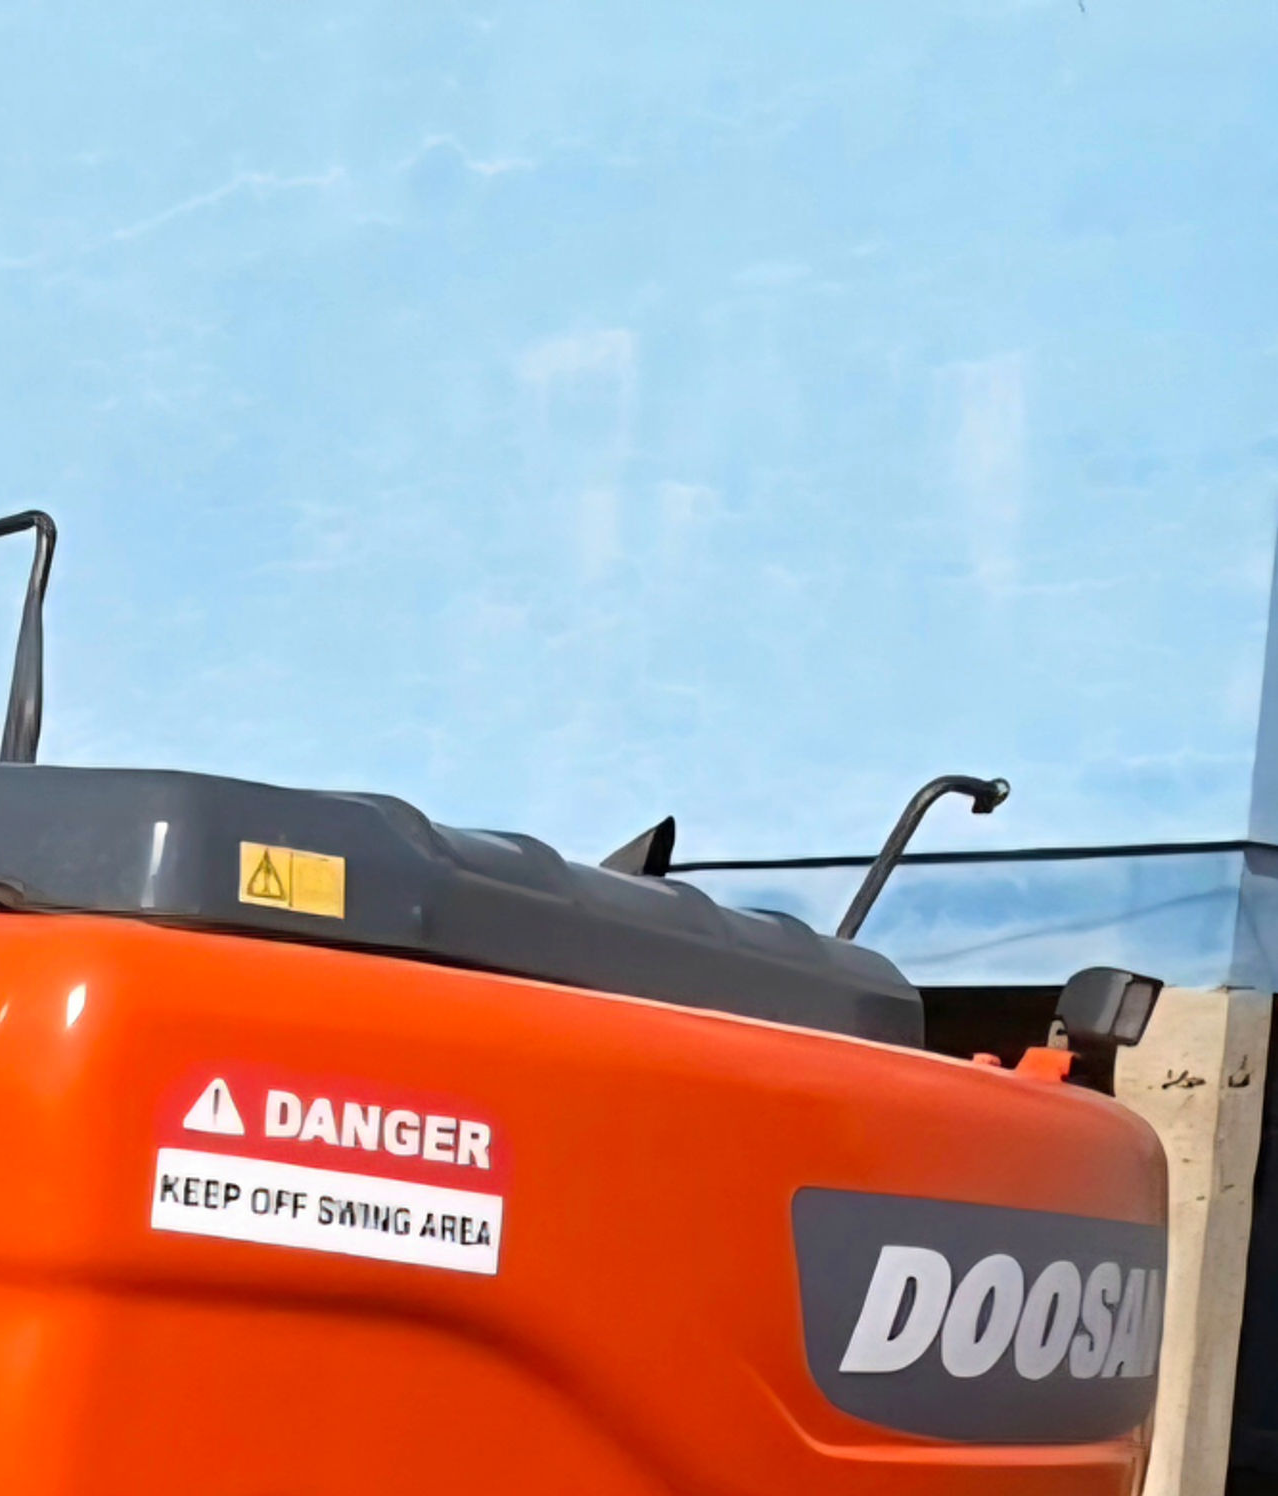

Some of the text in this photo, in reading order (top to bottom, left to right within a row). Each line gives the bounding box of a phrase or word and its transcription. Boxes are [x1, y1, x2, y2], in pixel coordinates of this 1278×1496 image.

[264, 1089, 492, 1169] DANGER
[160, 1174, 491, 1246] KEEP OFF SWING AREA
